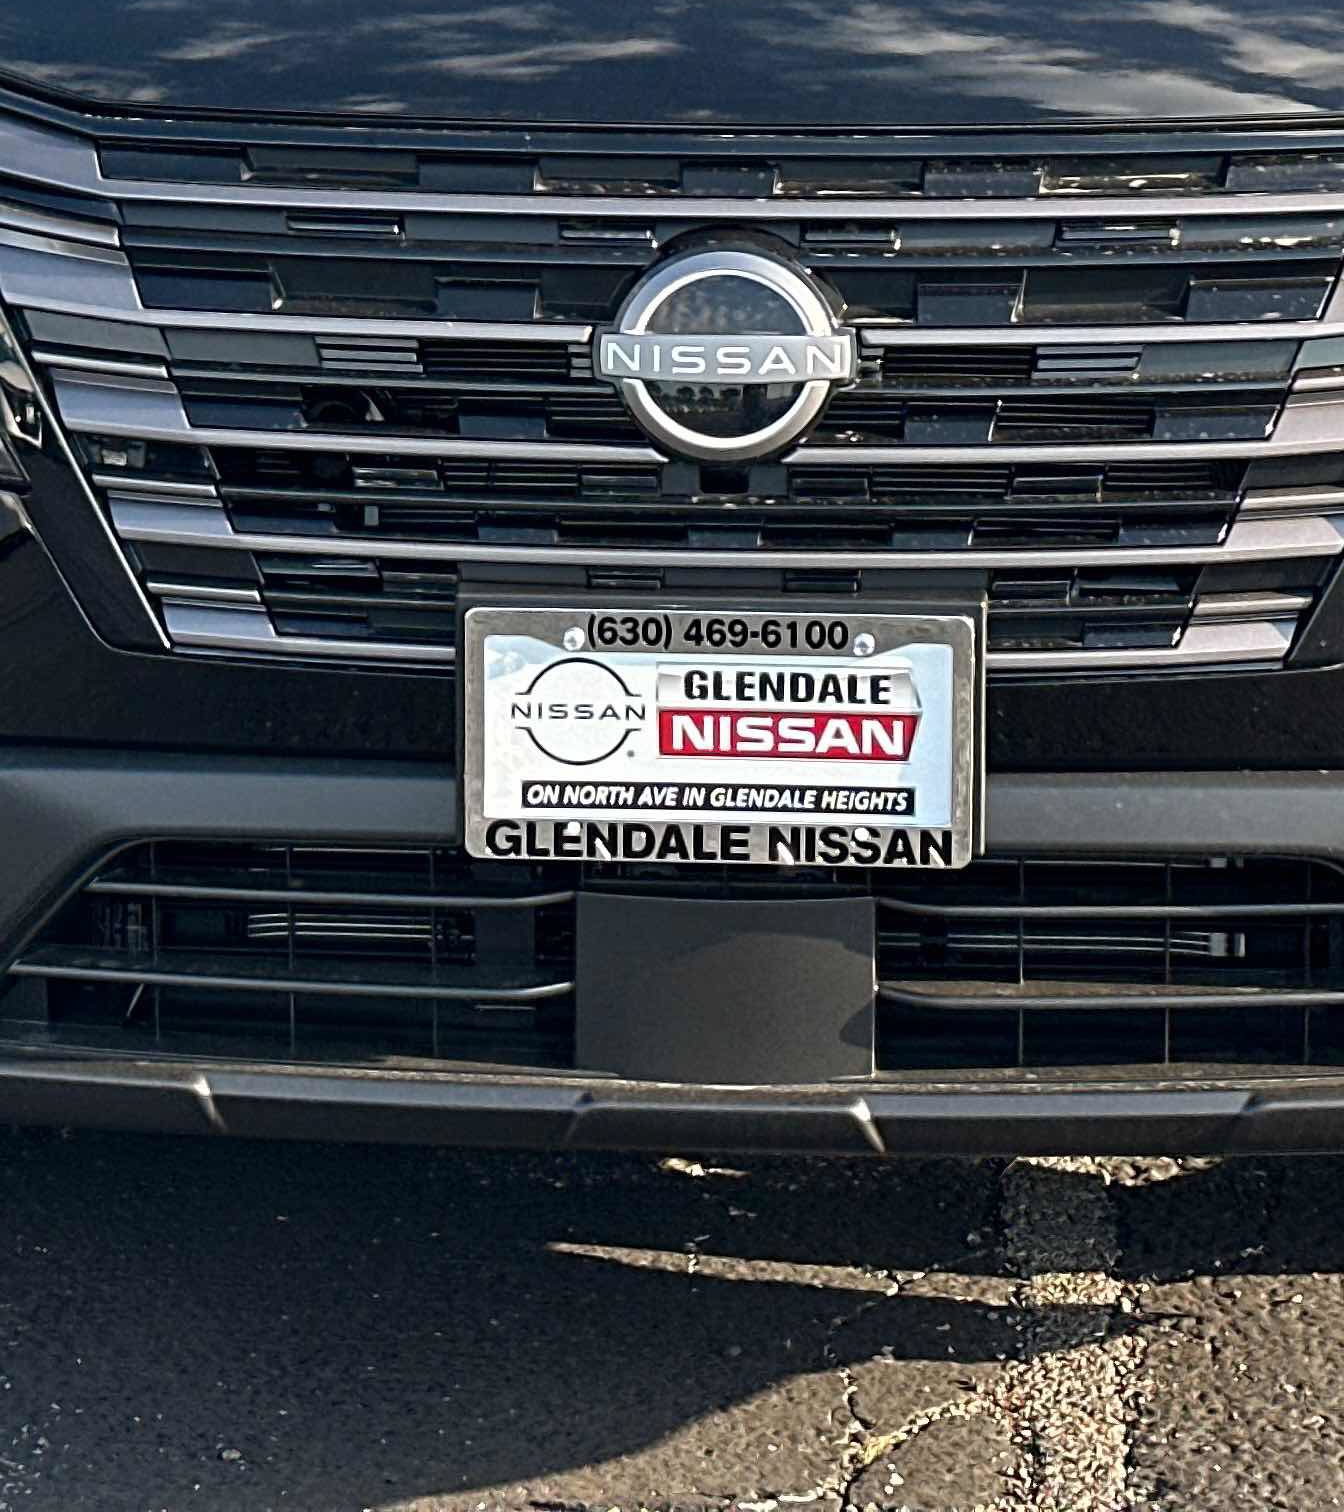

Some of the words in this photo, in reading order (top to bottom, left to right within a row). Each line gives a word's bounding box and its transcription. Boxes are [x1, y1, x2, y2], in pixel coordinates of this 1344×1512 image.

[607, 342, 842, 376] NISSAN
[587, 613, 672, 651] (630)
[683, 617, 850, 650] 469-6100
[683, 668, 892, 705] GLENDALE
[511, 702, 646, 720] NISSAN
[670, 713, 905, 756] NISSAN
[526, 784, 560, 805] ON
[563, 785, 635, 806] NORTH
[637, 786, 679, 807] AVE
[682, 786, 706, 807] IN
[710, 787, 818, 810] GLENDALE
[820, 790, 909, 812] HEIGHTS
[485, 819, 752, 861] GLENDALE
[768, 825, 953, 866] NISSAN
